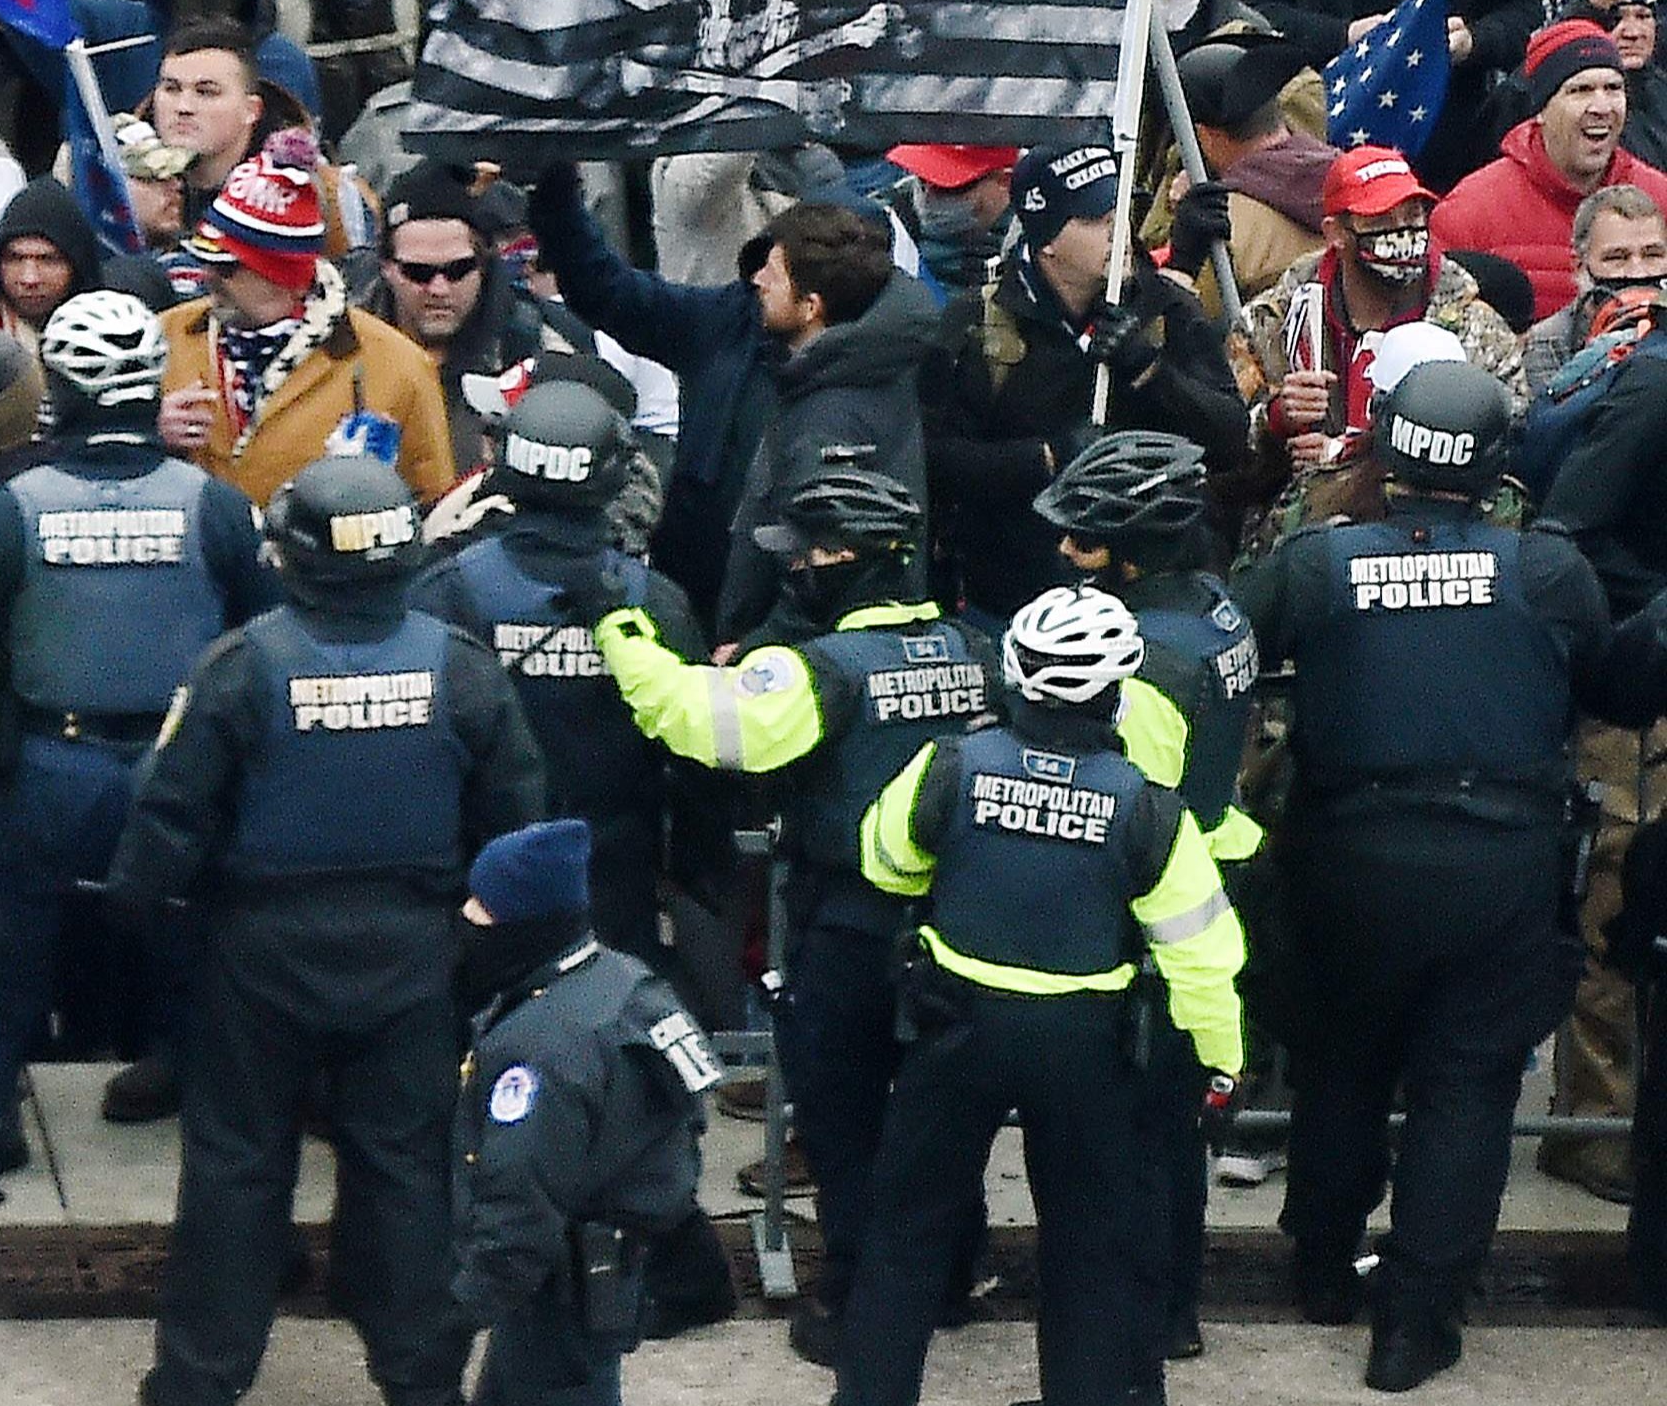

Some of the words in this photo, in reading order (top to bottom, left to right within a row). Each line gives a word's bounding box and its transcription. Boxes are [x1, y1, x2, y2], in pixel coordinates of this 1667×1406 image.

[1023, 187, 1047, 212] 45
[1393, 413, 1475, 466] MPDC
[507, 434, 592, 482] MPDC
[322, 505, 415, 553] MPDC
[43, 534, 181, 564] POLICE
[1349, 550, 1496, 585] METROPOLITAN
[1356, 577, 1493, 610] POLICE
[290, 671, 436, 707] METROPOLITAN
[869, 664, 986, 700] METROPOLITAN
[295, 697, 431, 733] POLICE
[876, 687, 987, 723] POLICE
[972, 773, 1115, 820] METROPOLITAN
[975, 800, 1106, 844] POLICE
